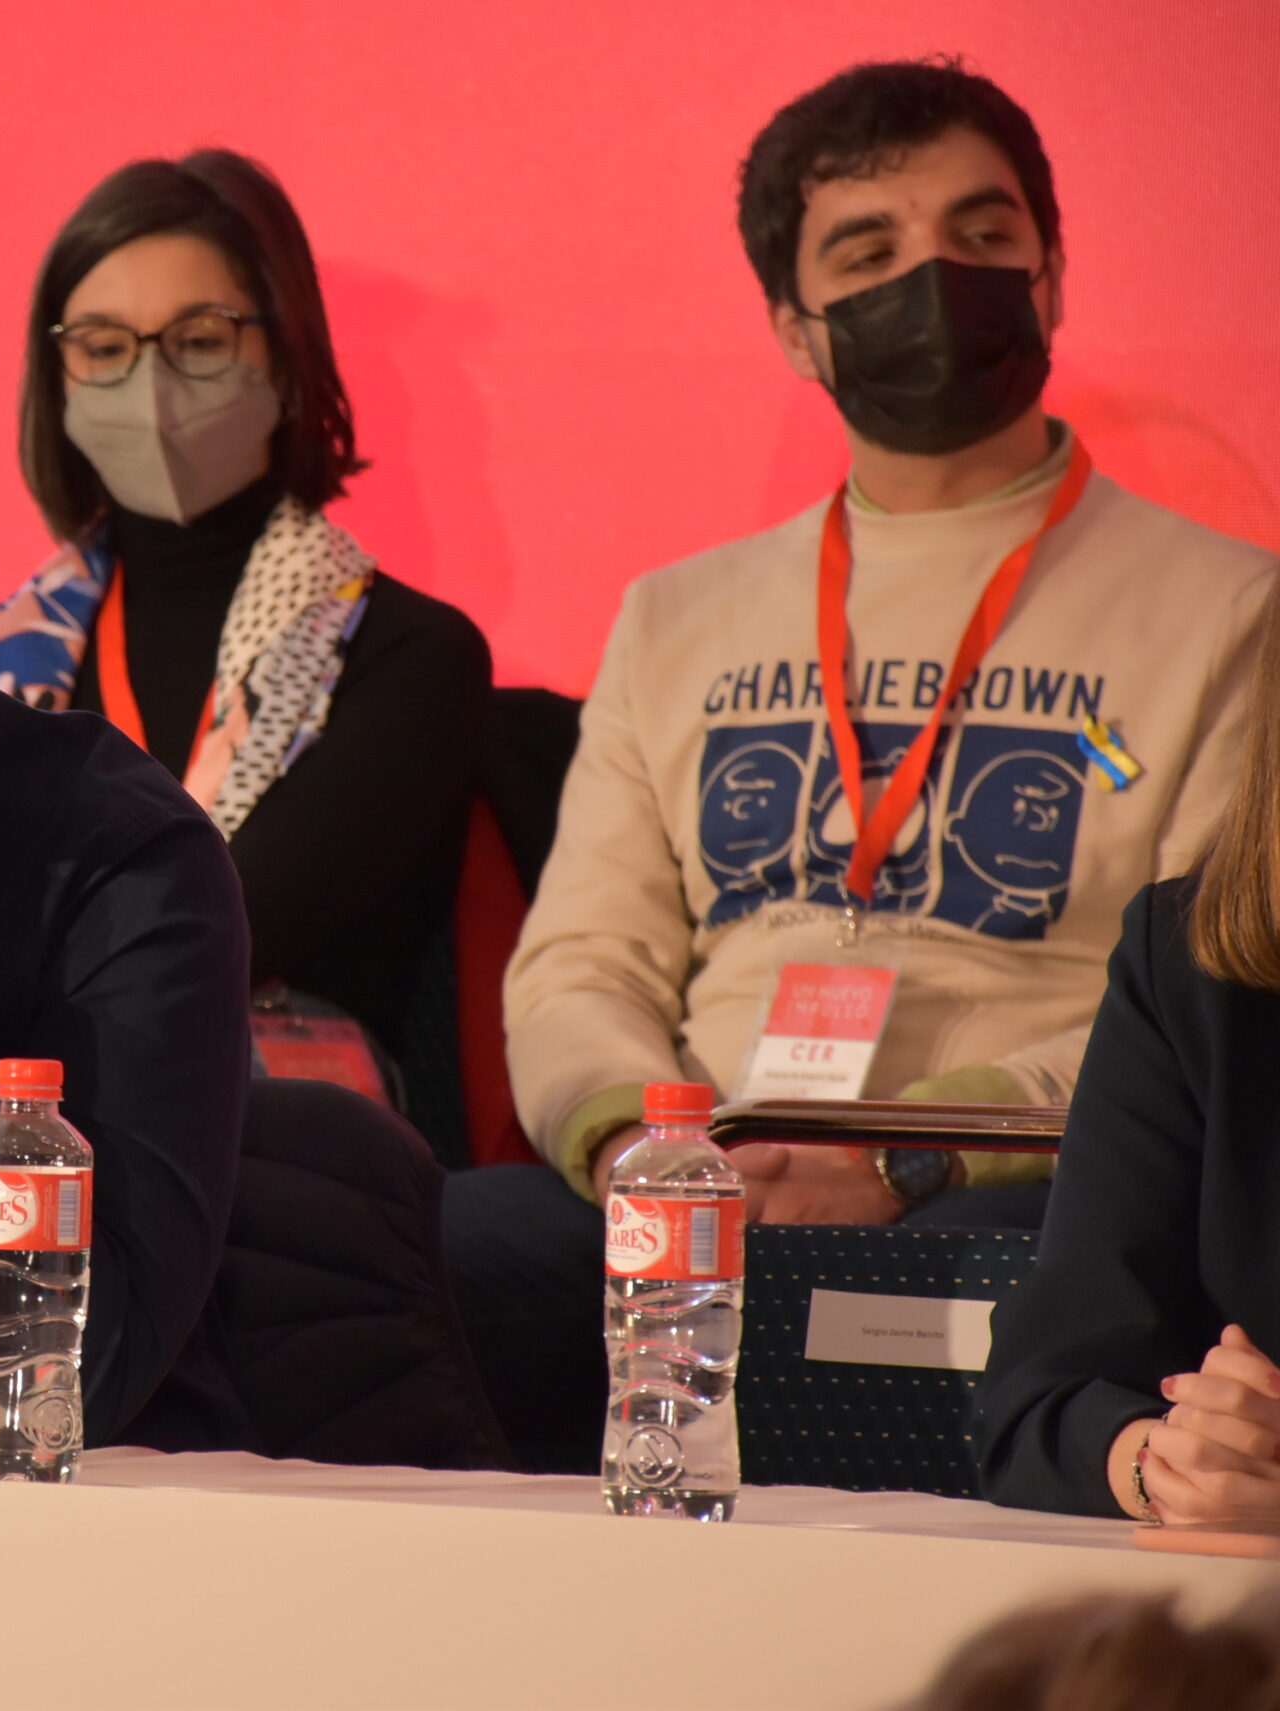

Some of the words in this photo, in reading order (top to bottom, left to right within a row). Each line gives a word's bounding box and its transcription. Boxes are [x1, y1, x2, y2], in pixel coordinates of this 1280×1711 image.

[790, 1042, 836, 1063] CER
[607, 1222, 658, 1254] LARES
[861, 1326, 888, 1337] Sergio
[889, 1327, 914, 1338] Jaime
[916, 1329, 944, 1339] Benito
